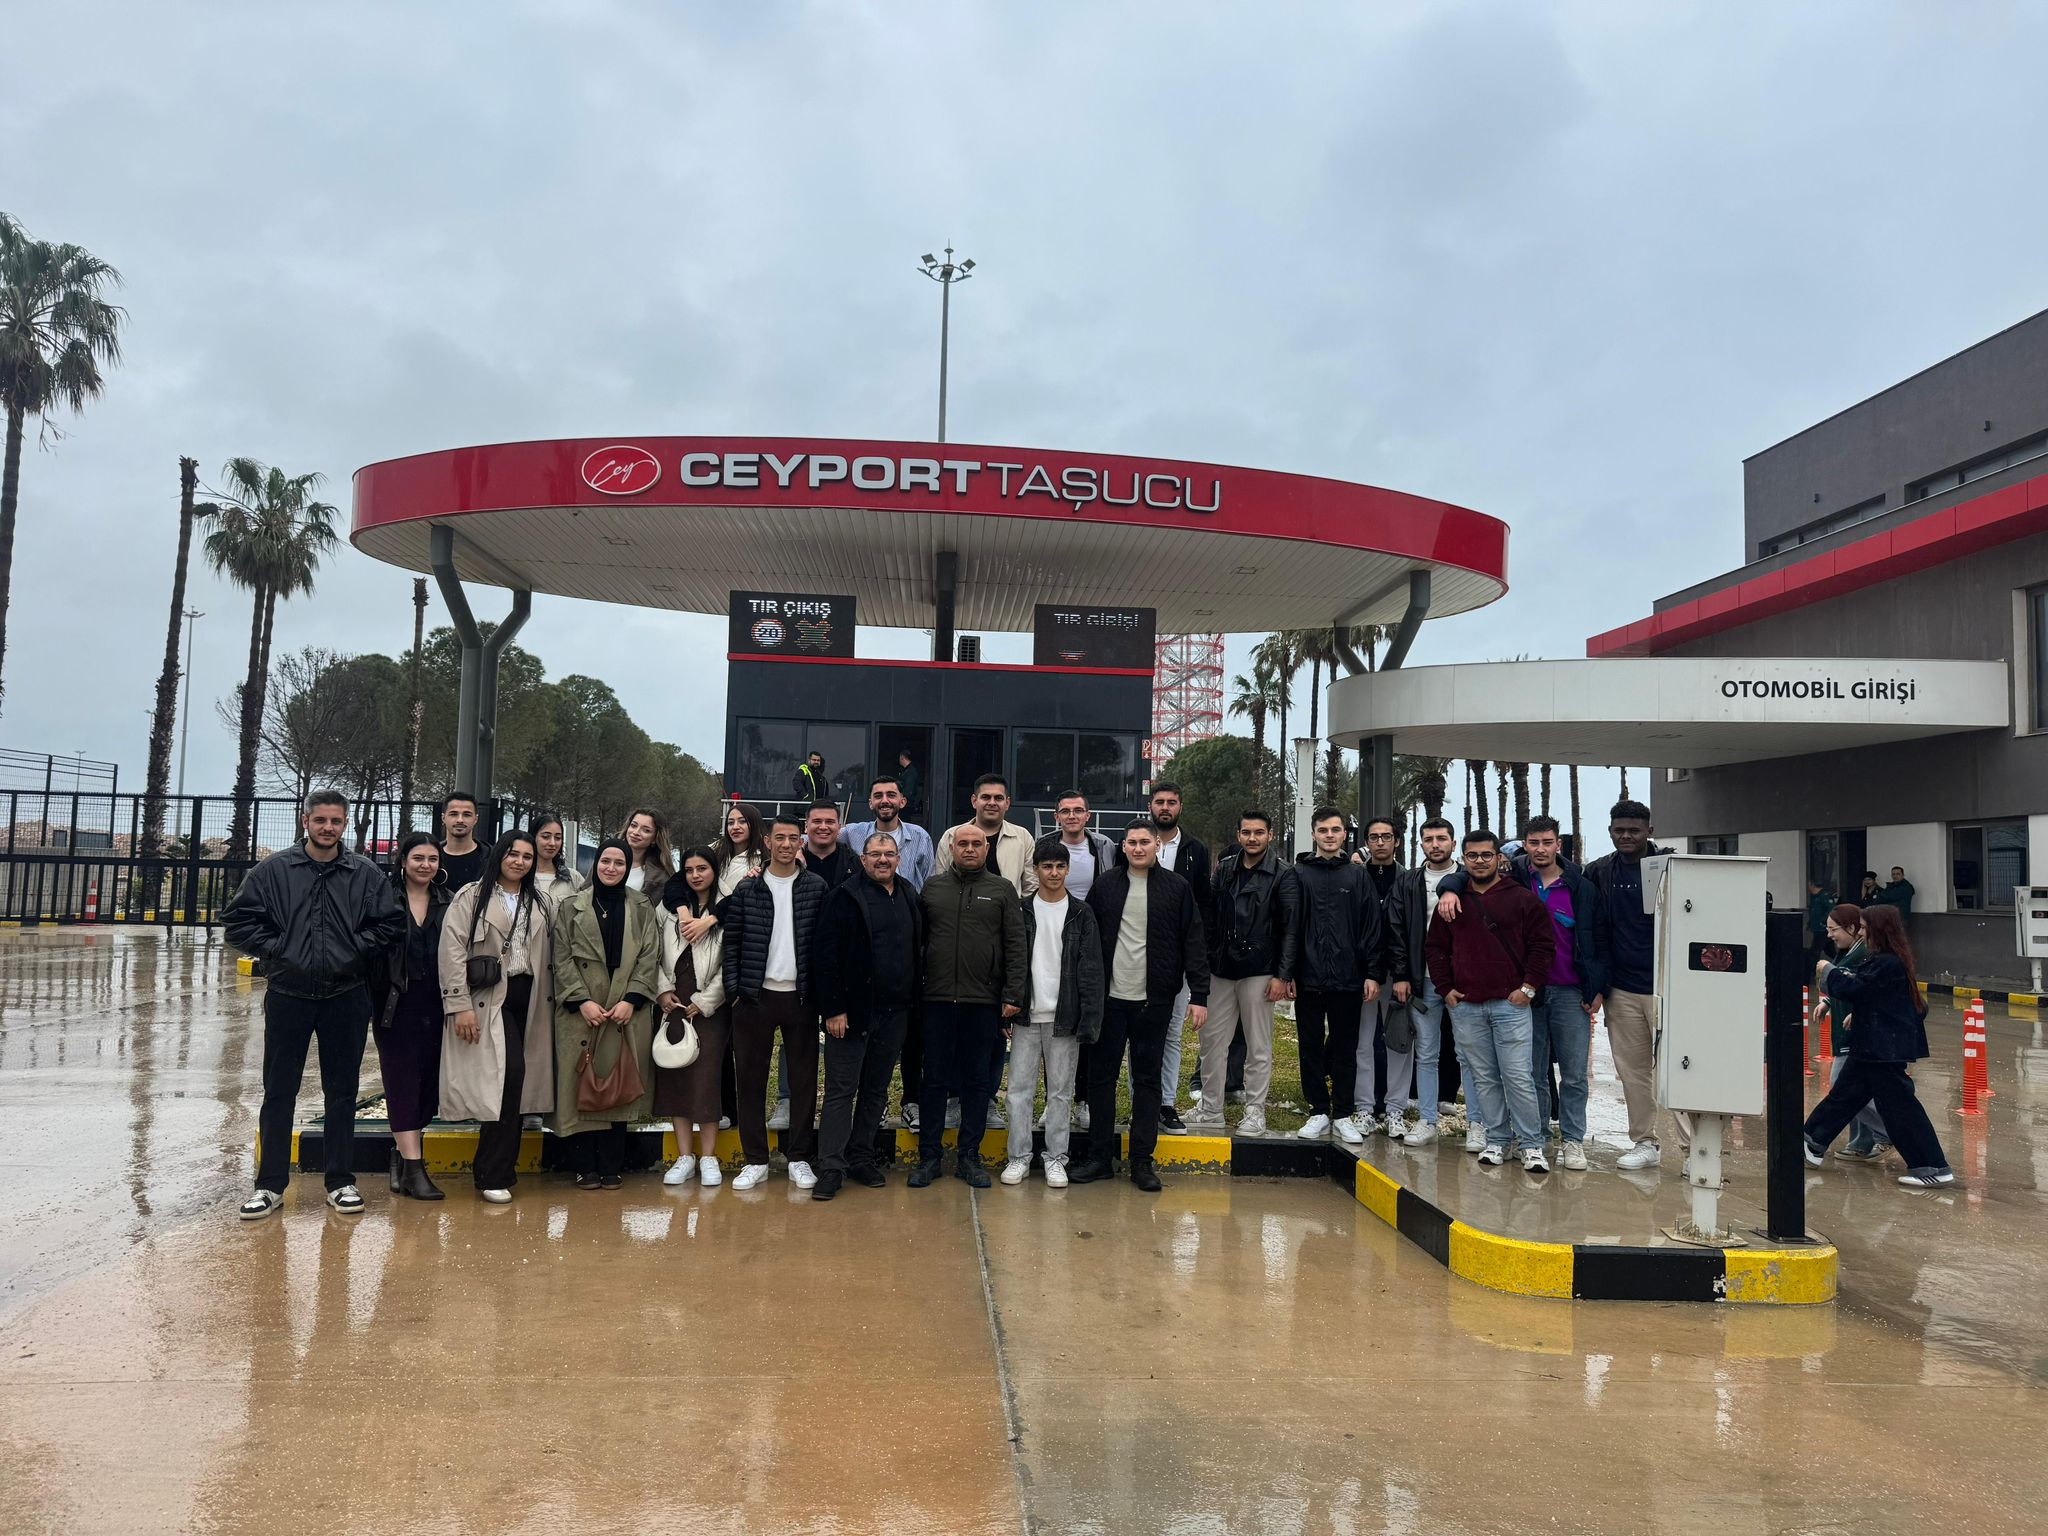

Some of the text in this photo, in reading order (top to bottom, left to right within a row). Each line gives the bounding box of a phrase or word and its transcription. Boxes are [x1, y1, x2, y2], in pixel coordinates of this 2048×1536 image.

[680, 452, 1221, 512] CEYPORT TAŞUCU
[749, 600, 831, 619] TIR ÇIKIŞ
[1054, 613, 1081, 624] TIR
[758, 627, 778, 637] 20
[1721, 677, 1916, 705] OTOMOBİL GİRİŞİ
